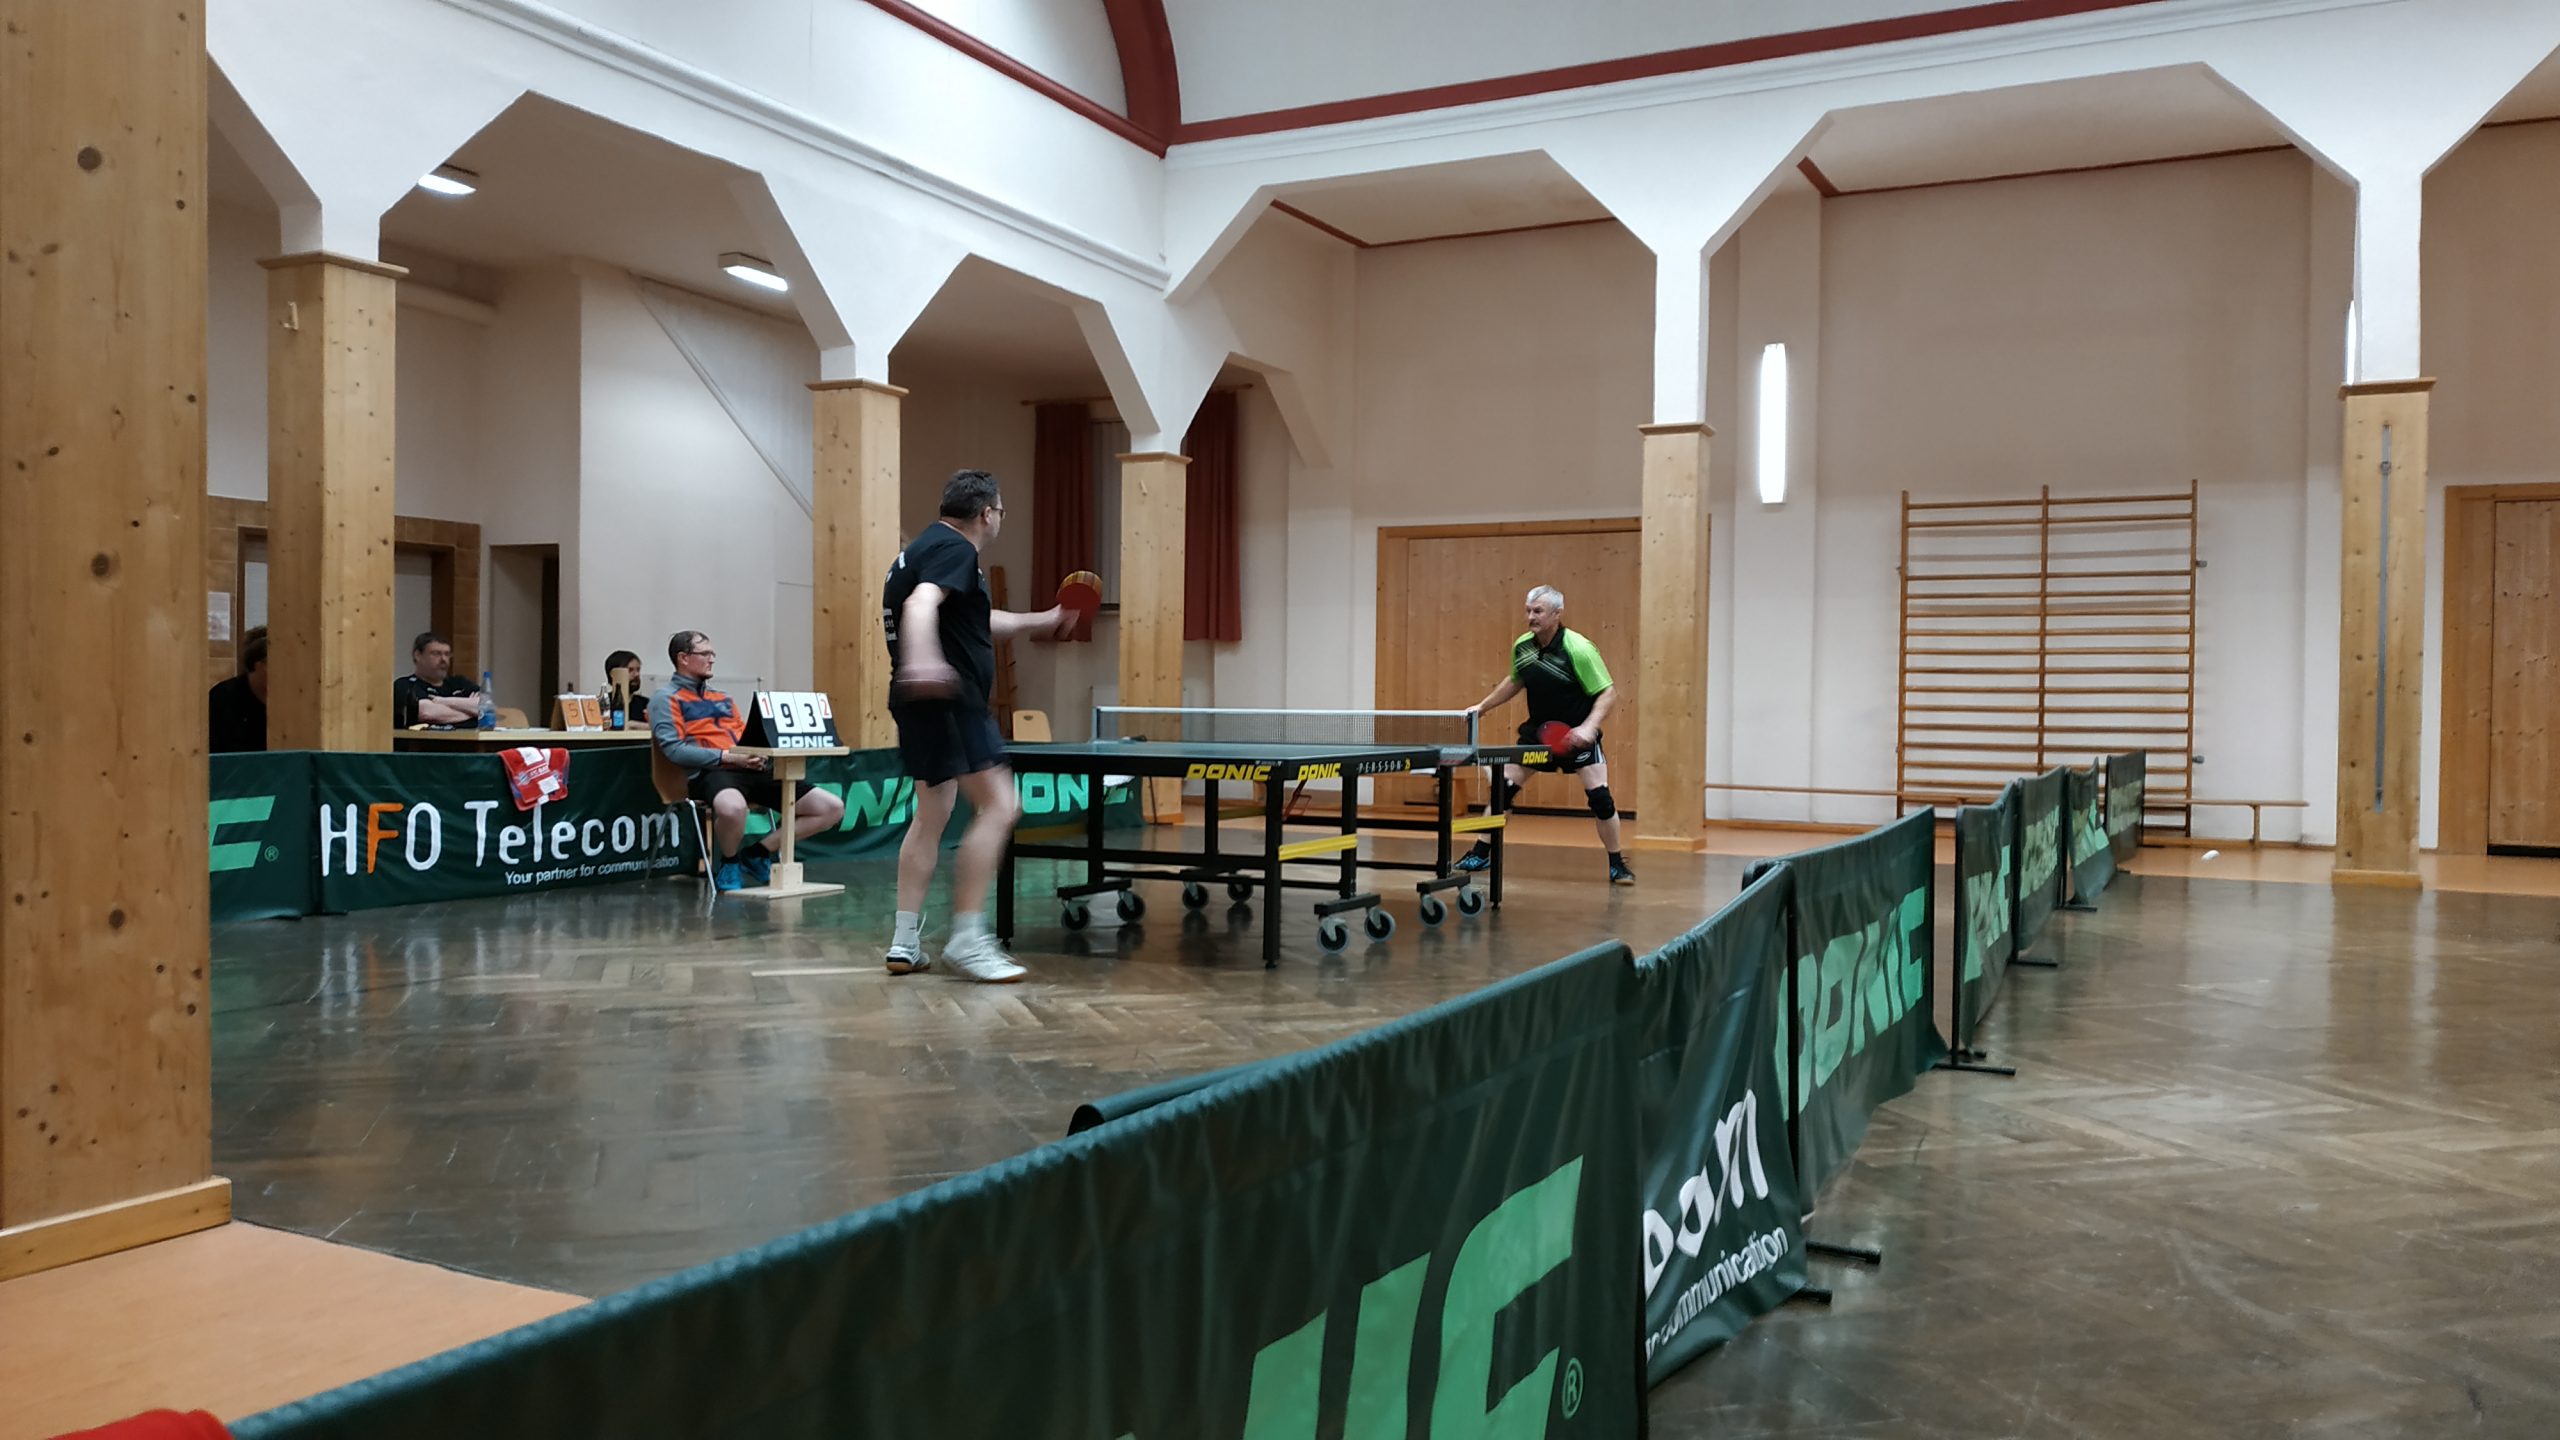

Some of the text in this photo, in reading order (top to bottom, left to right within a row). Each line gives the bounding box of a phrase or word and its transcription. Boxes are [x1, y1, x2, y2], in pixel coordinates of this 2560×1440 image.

[761, 697, 830, 728] 1 9 3 2
[777, 735, 835, 748] DONIC
[1522, 751, 1549, 764] DONIC
[1186, 763, 1272, 782] DONIC
[1297, 762, 1342, 782] DONIC
[319, 801, 442, 878] HFO
[463, 799, 681, 868] Telecom
[504, 855, 680, 886] Your partner for communiation
